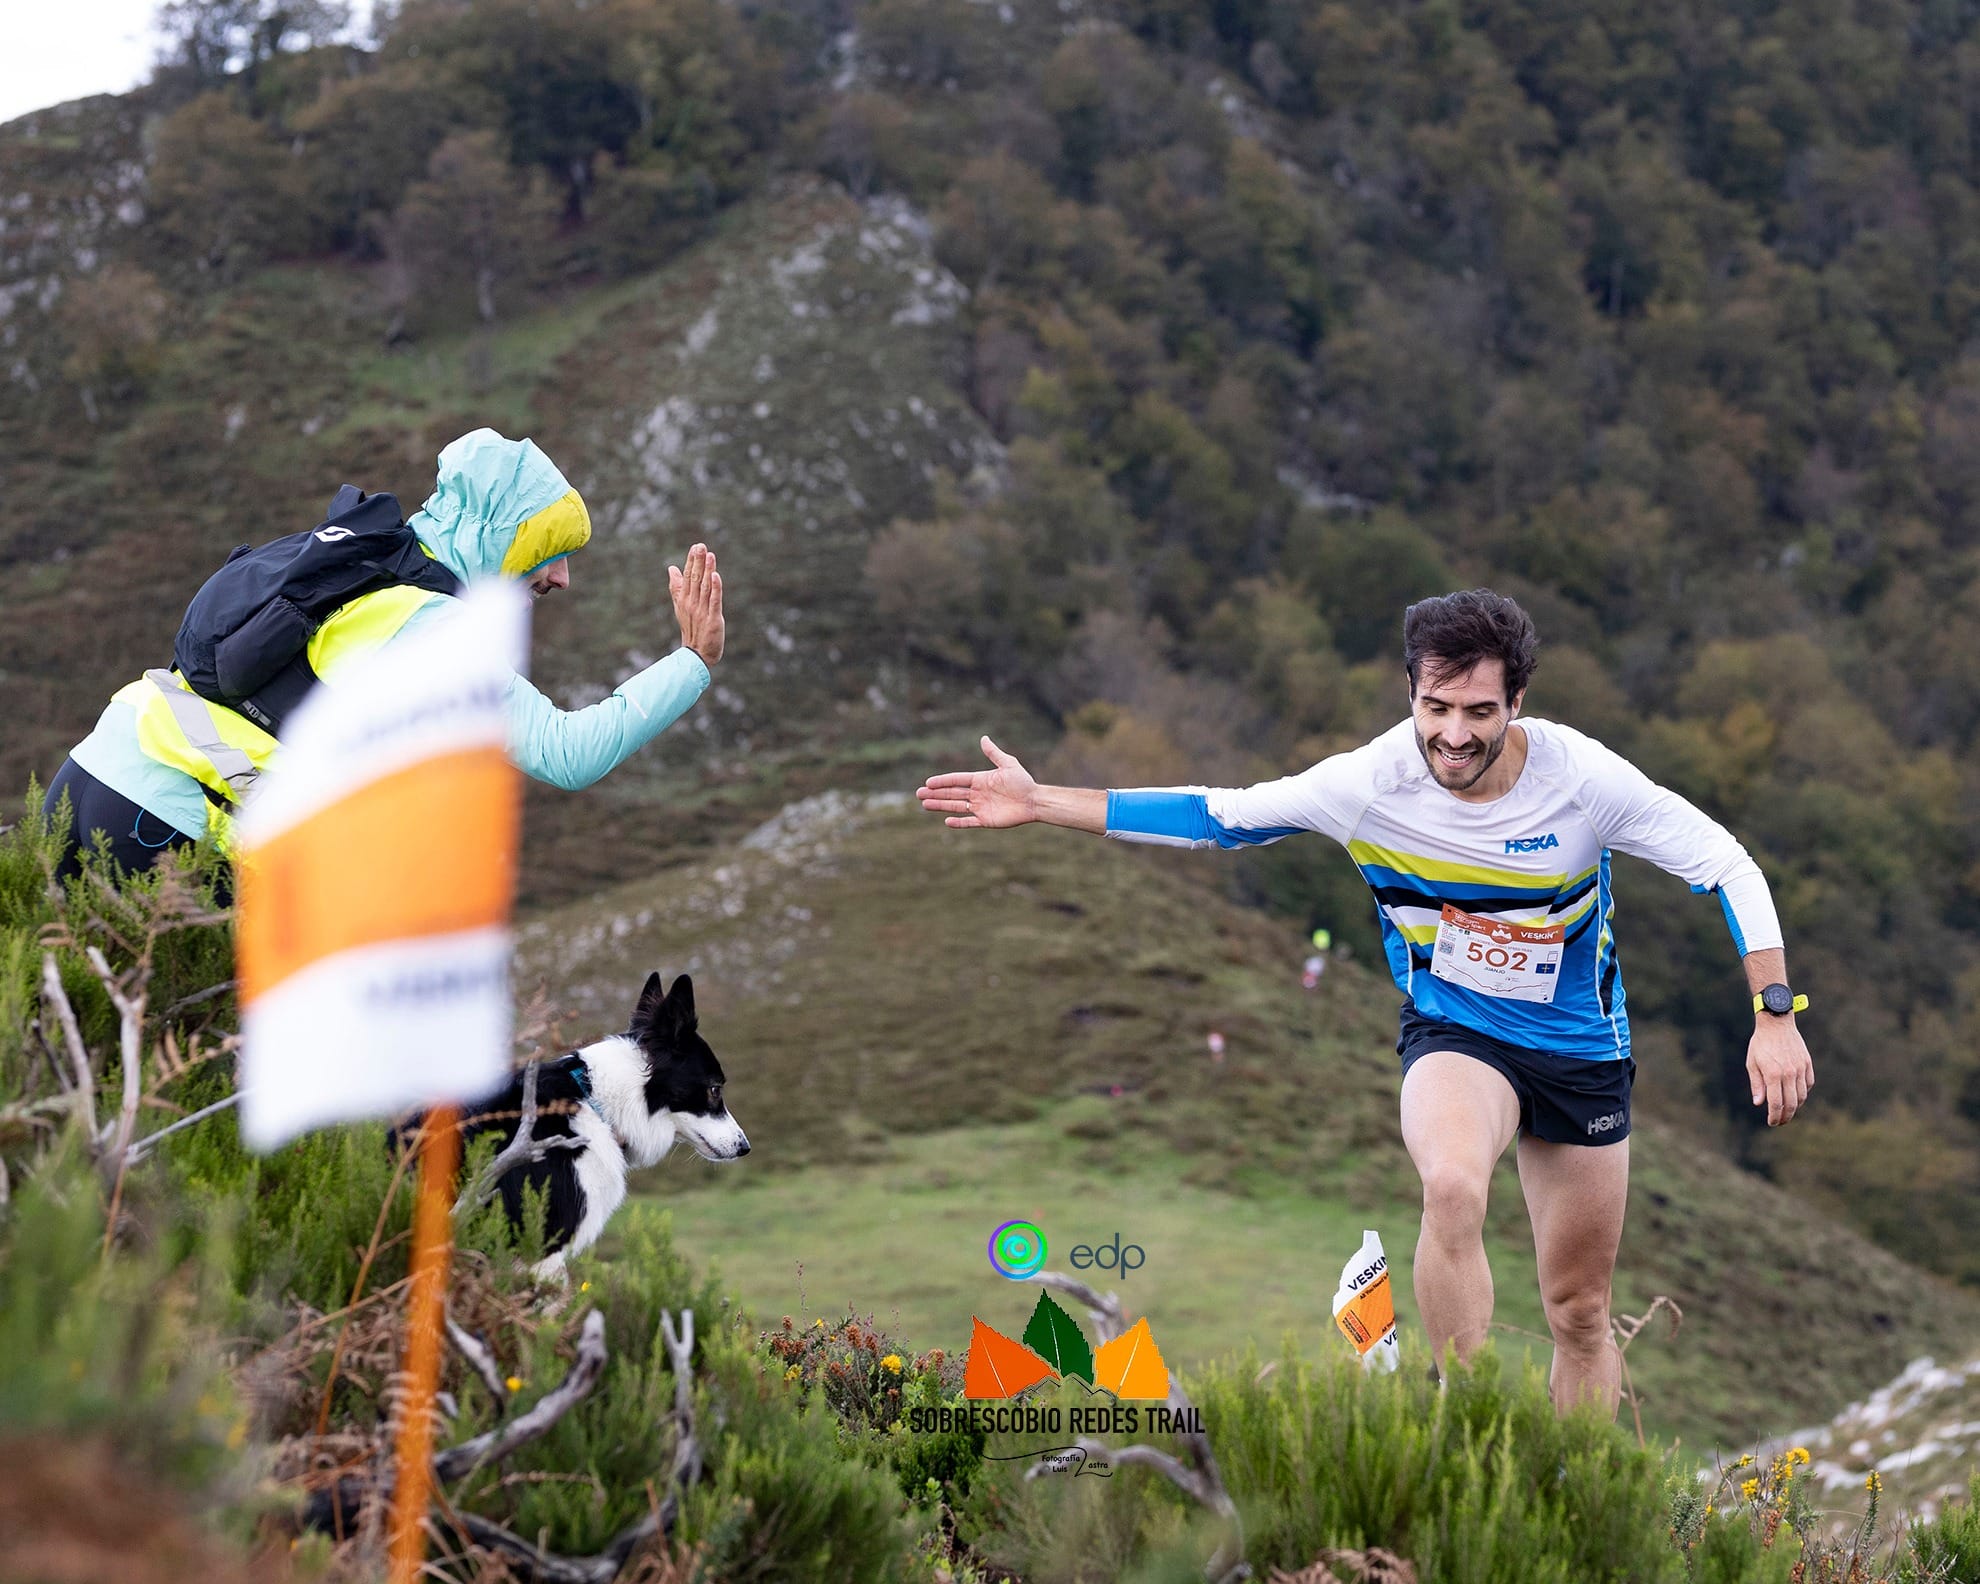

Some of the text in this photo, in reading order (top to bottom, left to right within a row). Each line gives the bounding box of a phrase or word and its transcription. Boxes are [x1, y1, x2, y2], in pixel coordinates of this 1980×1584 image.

[1504, 833, 1559, 854] HOKA
[1467, 942, 1528, 971] 502
[1587, 1110, 1625, 1135] HOKA
